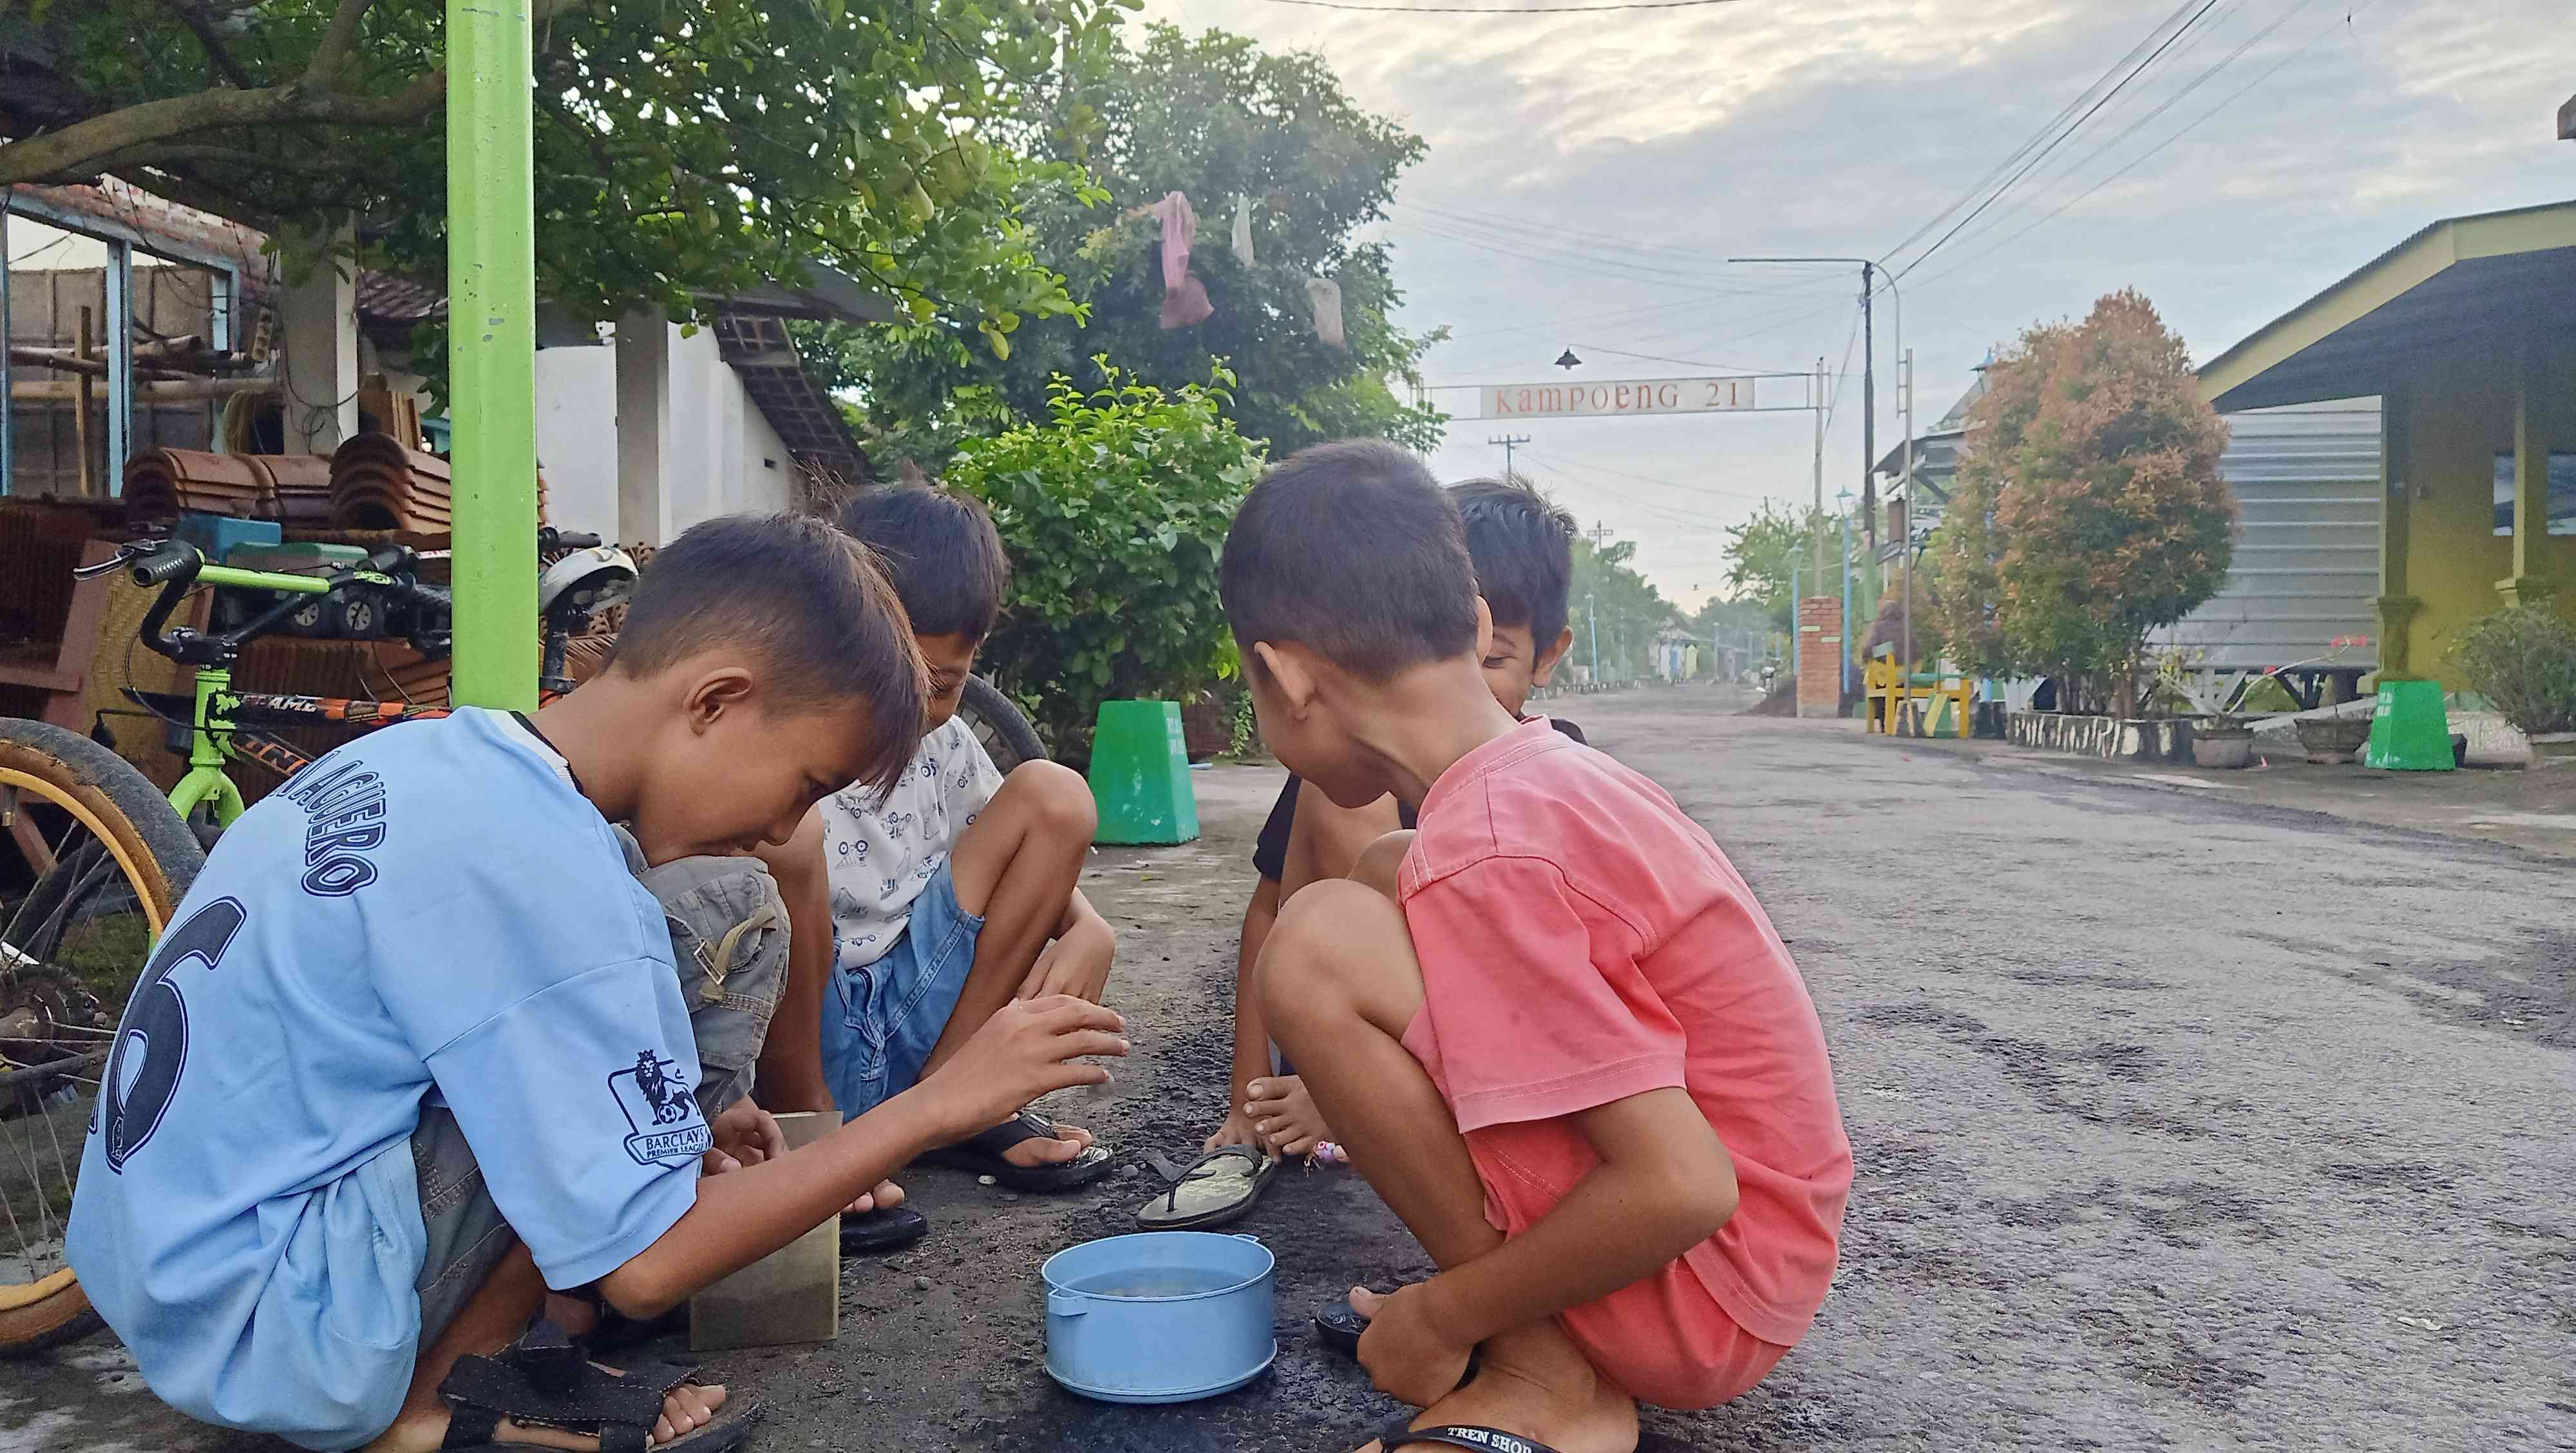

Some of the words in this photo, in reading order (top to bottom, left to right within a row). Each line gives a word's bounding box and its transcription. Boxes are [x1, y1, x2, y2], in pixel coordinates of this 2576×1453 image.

[1705, 381, 1738, 407] 21
[289, 759, 386, 897] AGUERO
[646, 1128, 704, 1150] BARCLAYS
[647, 1148, 678, 1158] PREMIER
[1448, 1427, 1490, 1444] TREN
